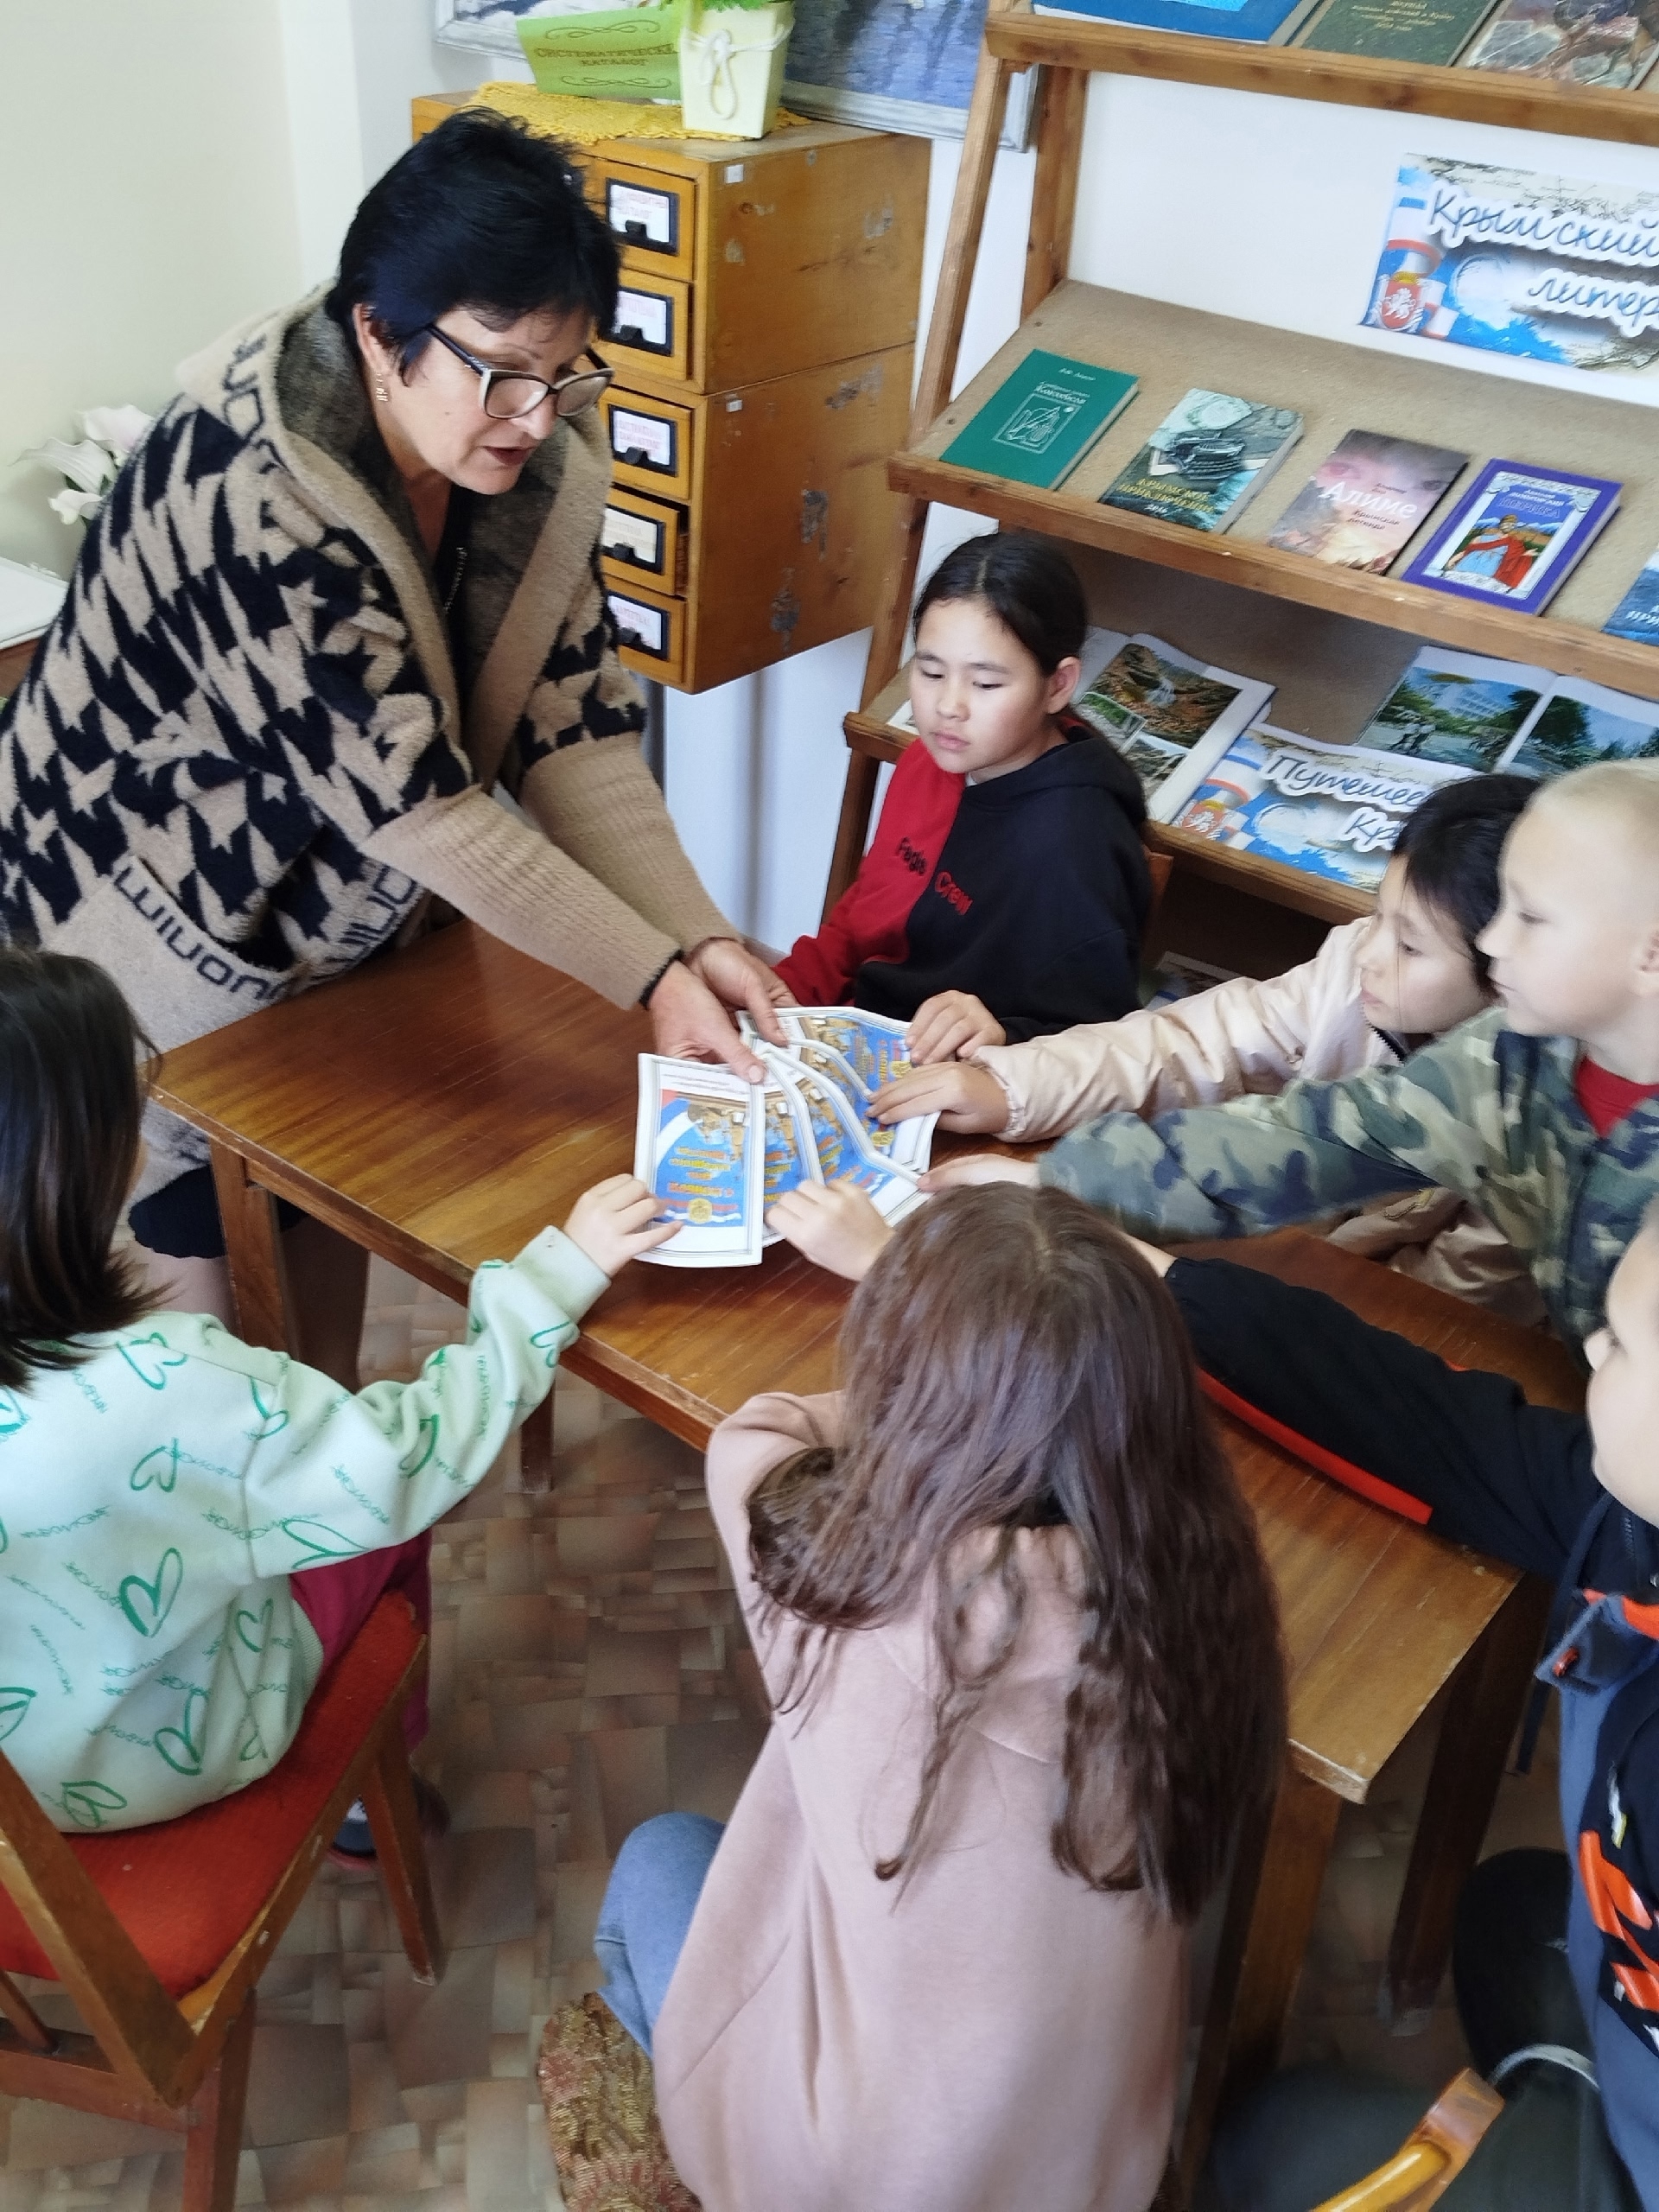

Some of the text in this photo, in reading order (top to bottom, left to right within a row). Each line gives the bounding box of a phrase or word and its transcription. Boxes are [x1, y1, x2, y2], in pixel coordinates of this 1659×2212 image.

[580, 58, 649, 67] КАТАЛОГ
[1429, 188, 1659, 259] Крымский
[1318, 480, 1418, 519] Алиме
[1352, 508, 1401, 525] Крымская
